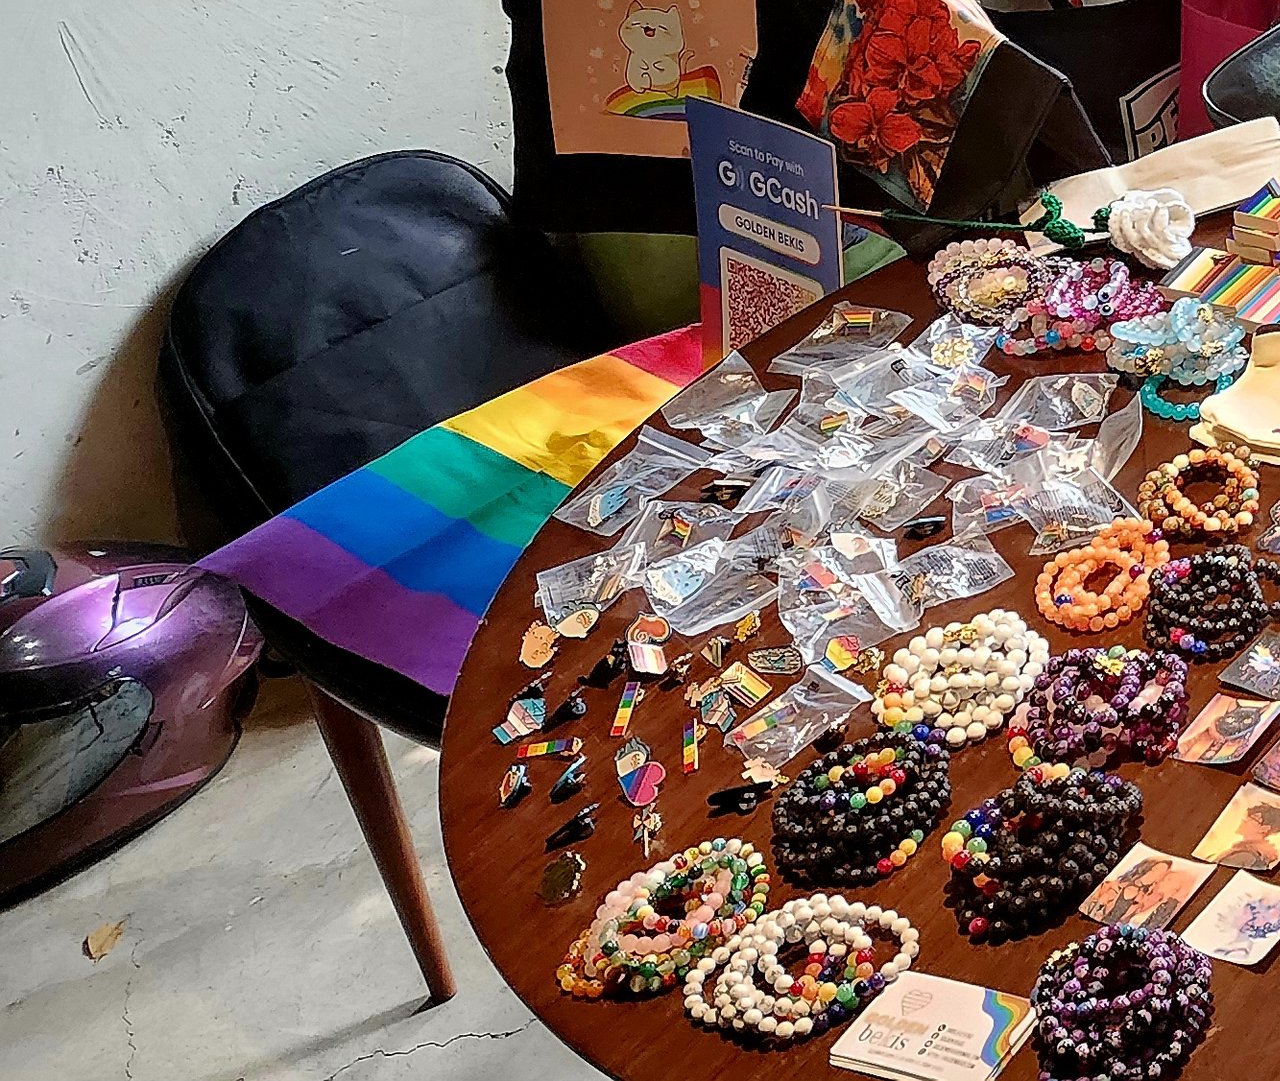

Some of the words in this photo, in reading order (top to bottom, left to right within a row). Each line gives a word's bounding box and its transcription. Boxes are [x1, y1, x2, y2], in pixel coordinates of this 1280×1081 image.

[728, 139, 754, 158] Scan
[754, 147, 764, 162] to
[766, 152, 785, 172] Pay
[785, 160, 805, 177] with
[749, 171, 820, 220] GCash
[735, 215, 775, 242] GOLDEN
[778, 231, 805, 253] BEKIS
